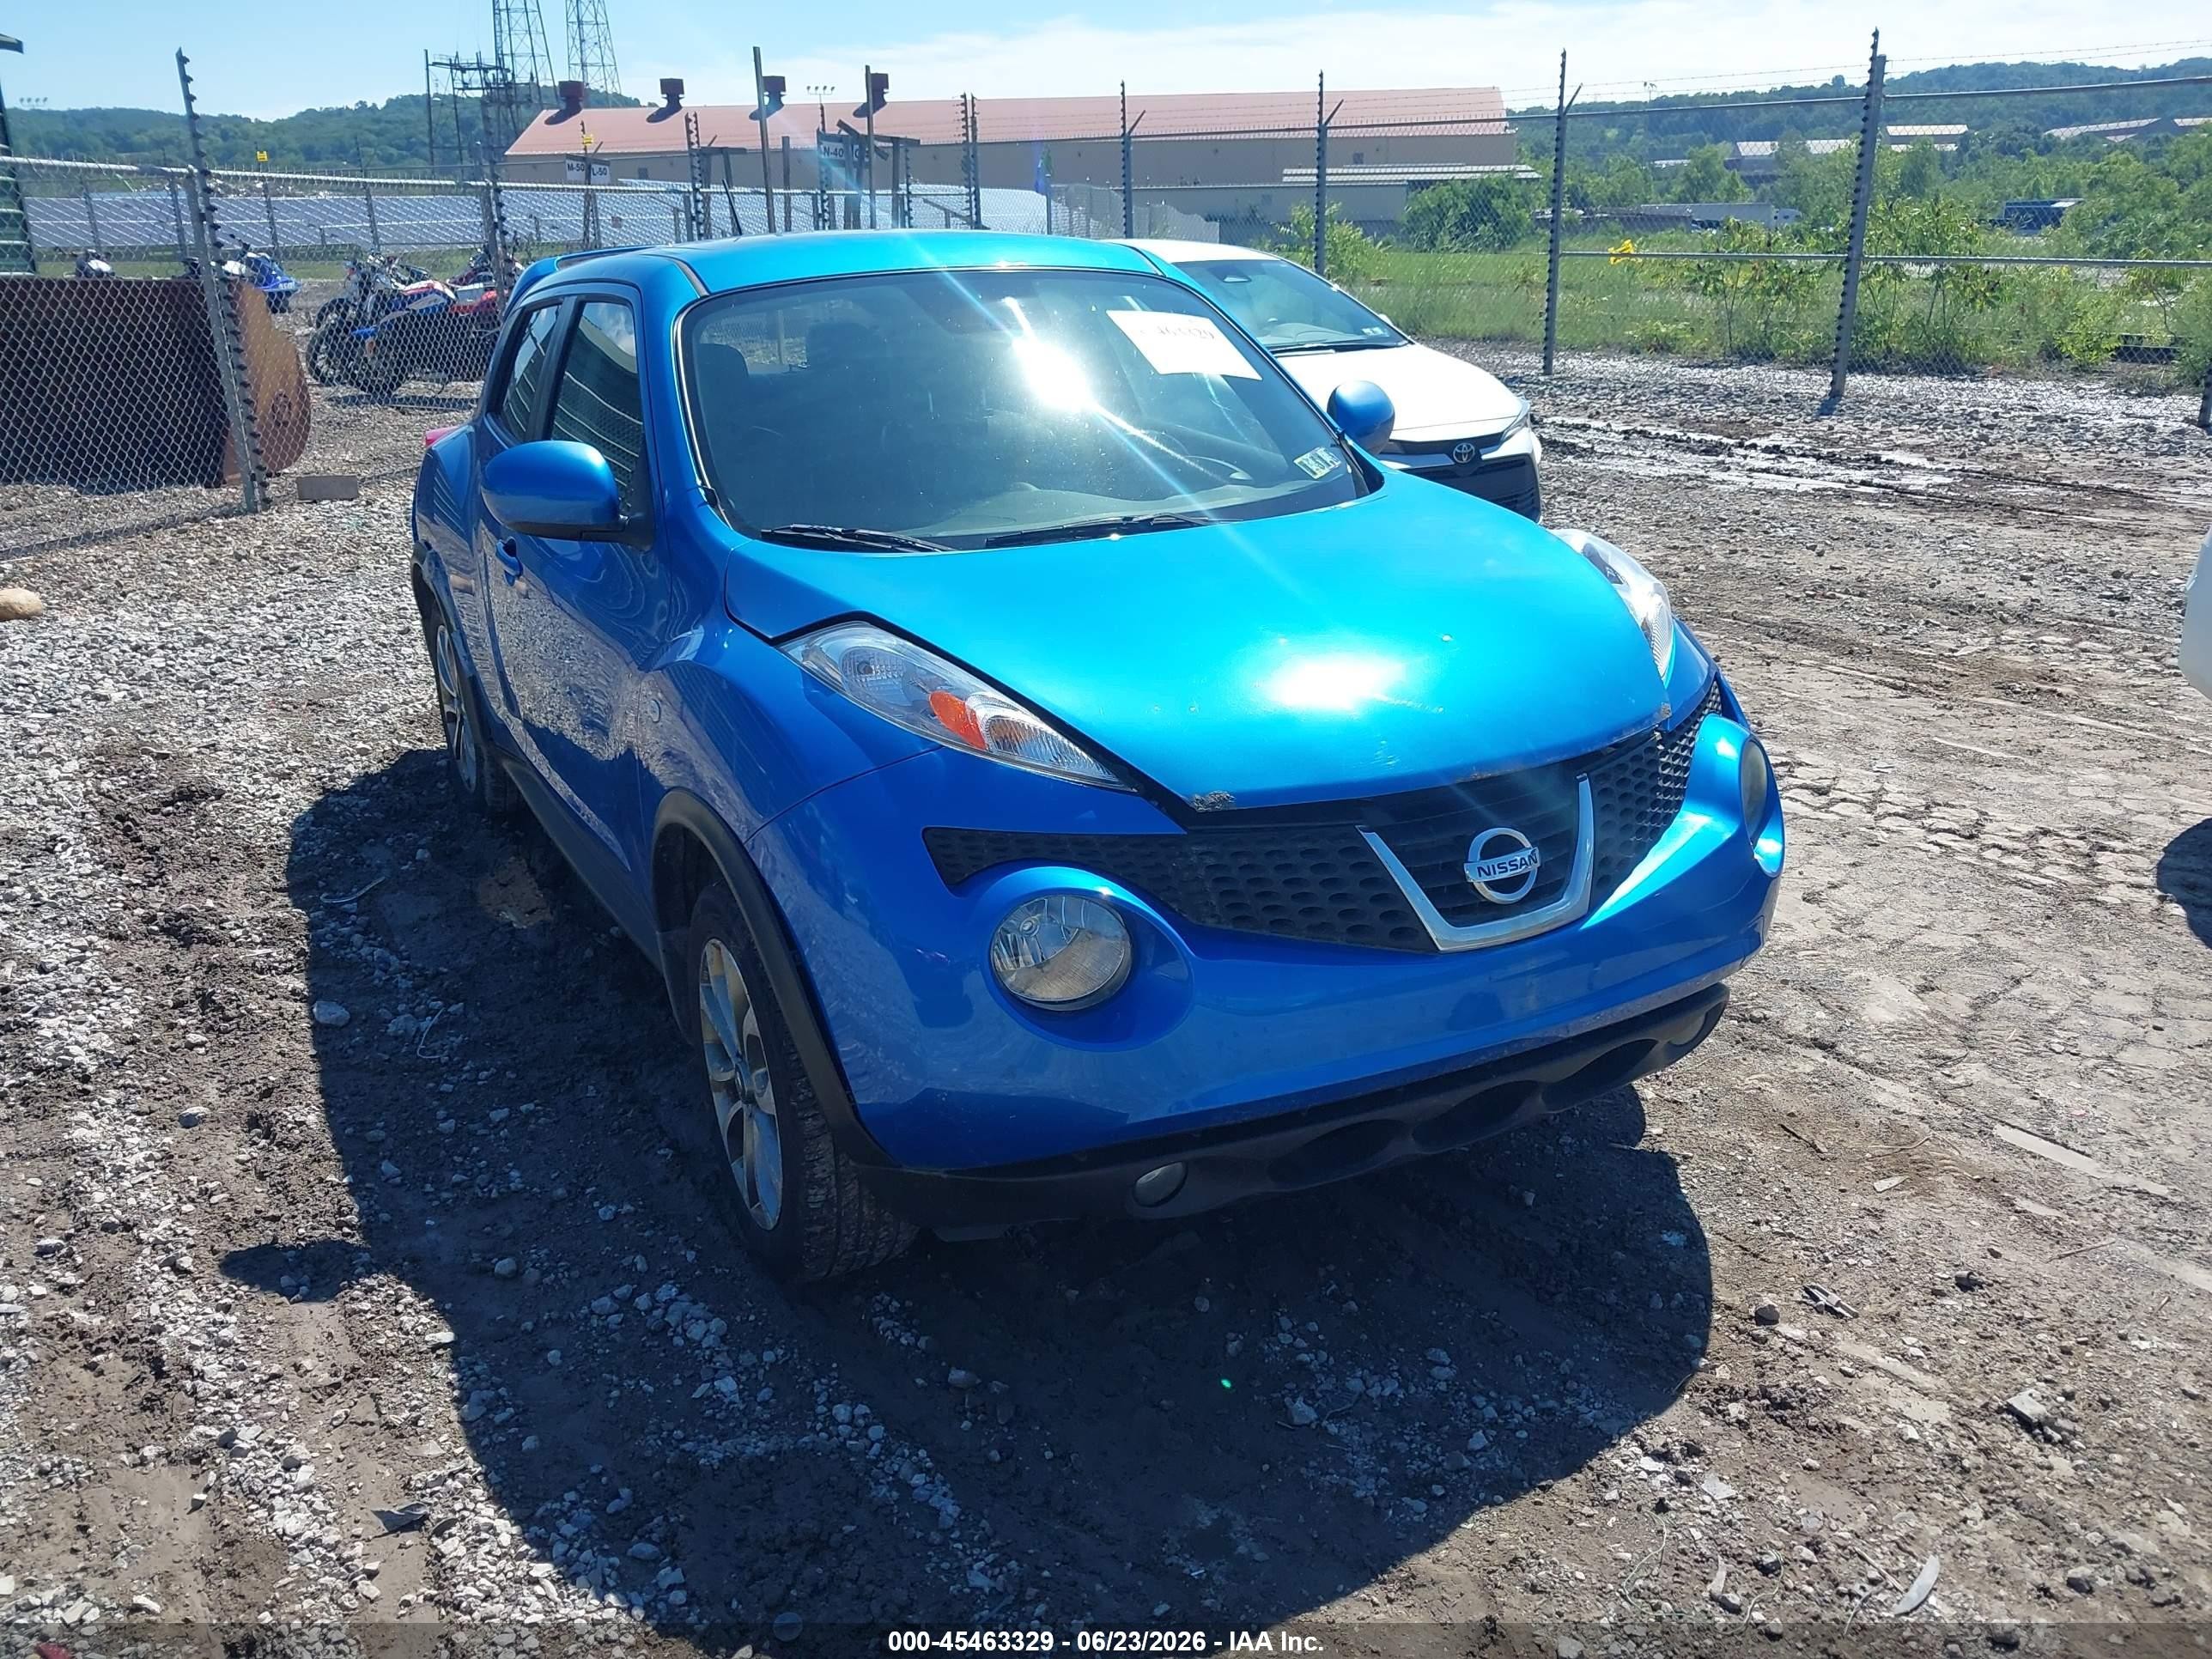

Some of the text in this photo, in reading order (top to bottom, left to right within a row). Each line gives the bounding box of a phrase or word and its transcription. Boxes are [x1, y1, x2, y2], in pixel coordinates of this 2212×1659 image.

[823, 146, 844, 157] N-40
[567, 162, 585, 173] M-50
[592, 167, 608, 177] L-50
[1477, 849, 1538, 878] NISSAN
